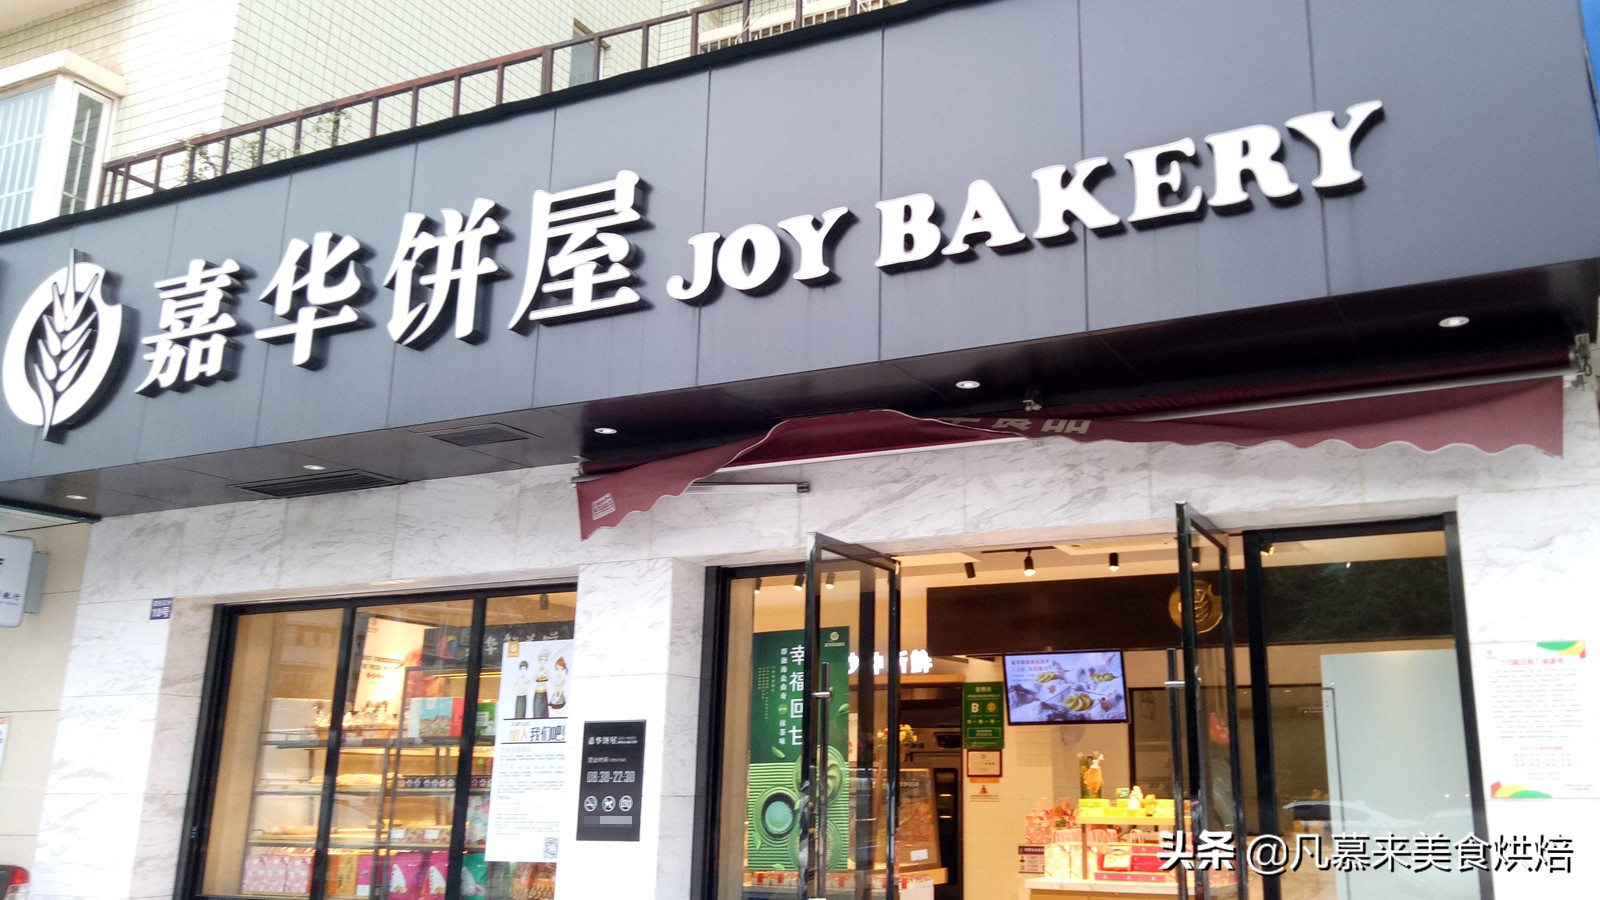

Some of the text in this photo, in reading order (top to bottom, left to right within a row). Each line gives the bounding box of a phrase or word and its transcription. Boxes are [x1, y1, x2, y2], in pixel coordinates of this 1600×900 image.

[134, 169, 646, 396] 嘉华饼屋
[667, 100, 1384, 302] JOY BAKERY
